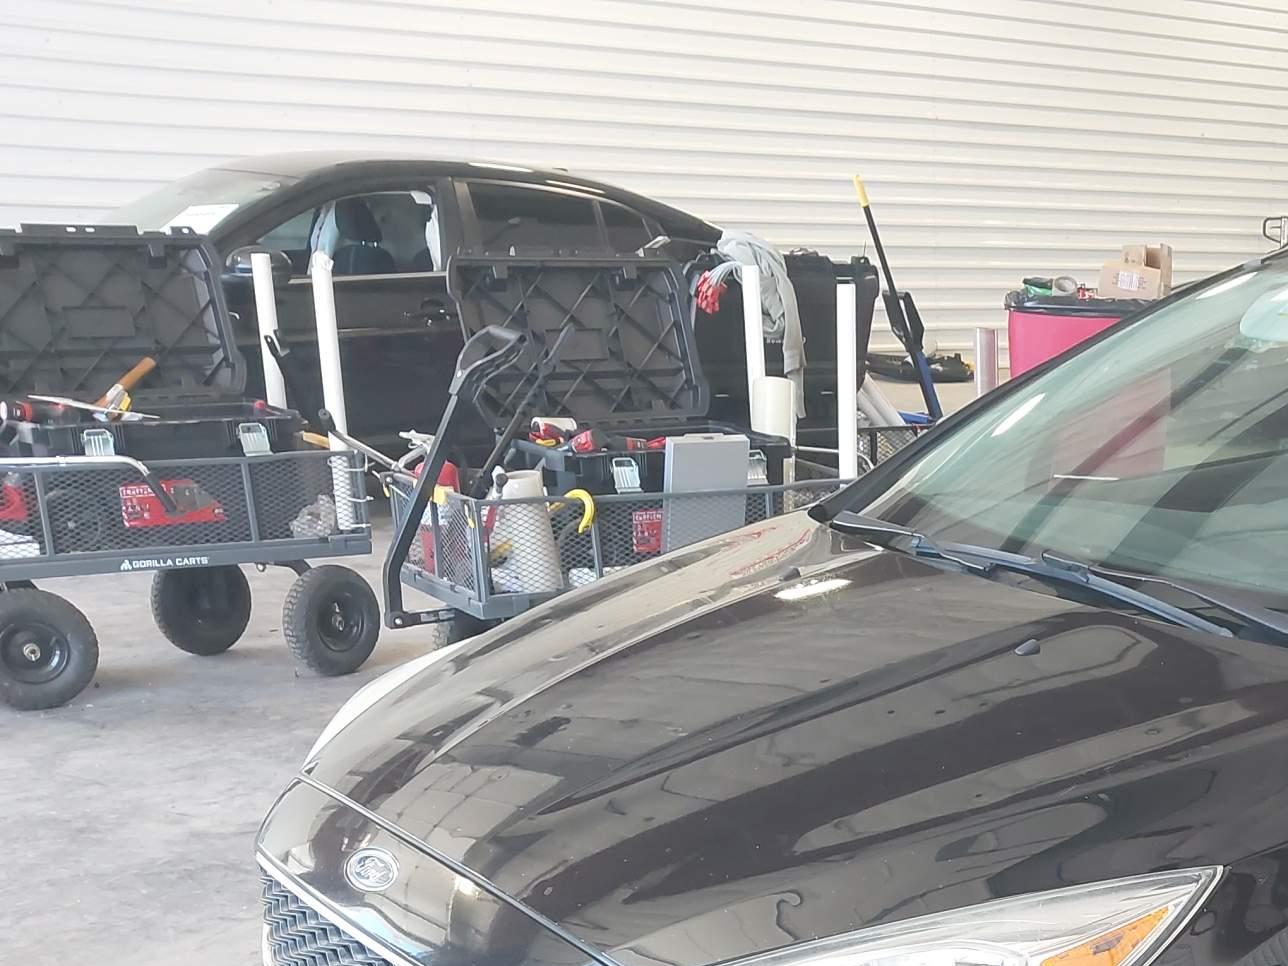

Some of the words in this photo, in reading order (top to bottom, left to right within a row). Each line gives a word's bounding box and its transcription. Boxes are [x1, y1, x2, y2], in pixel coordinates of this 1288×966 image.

[122, 486, 155, 497] CRAFTS
[132, 558, 174, 569] GORILLA
[175, 556, 209, 566] CARTS
